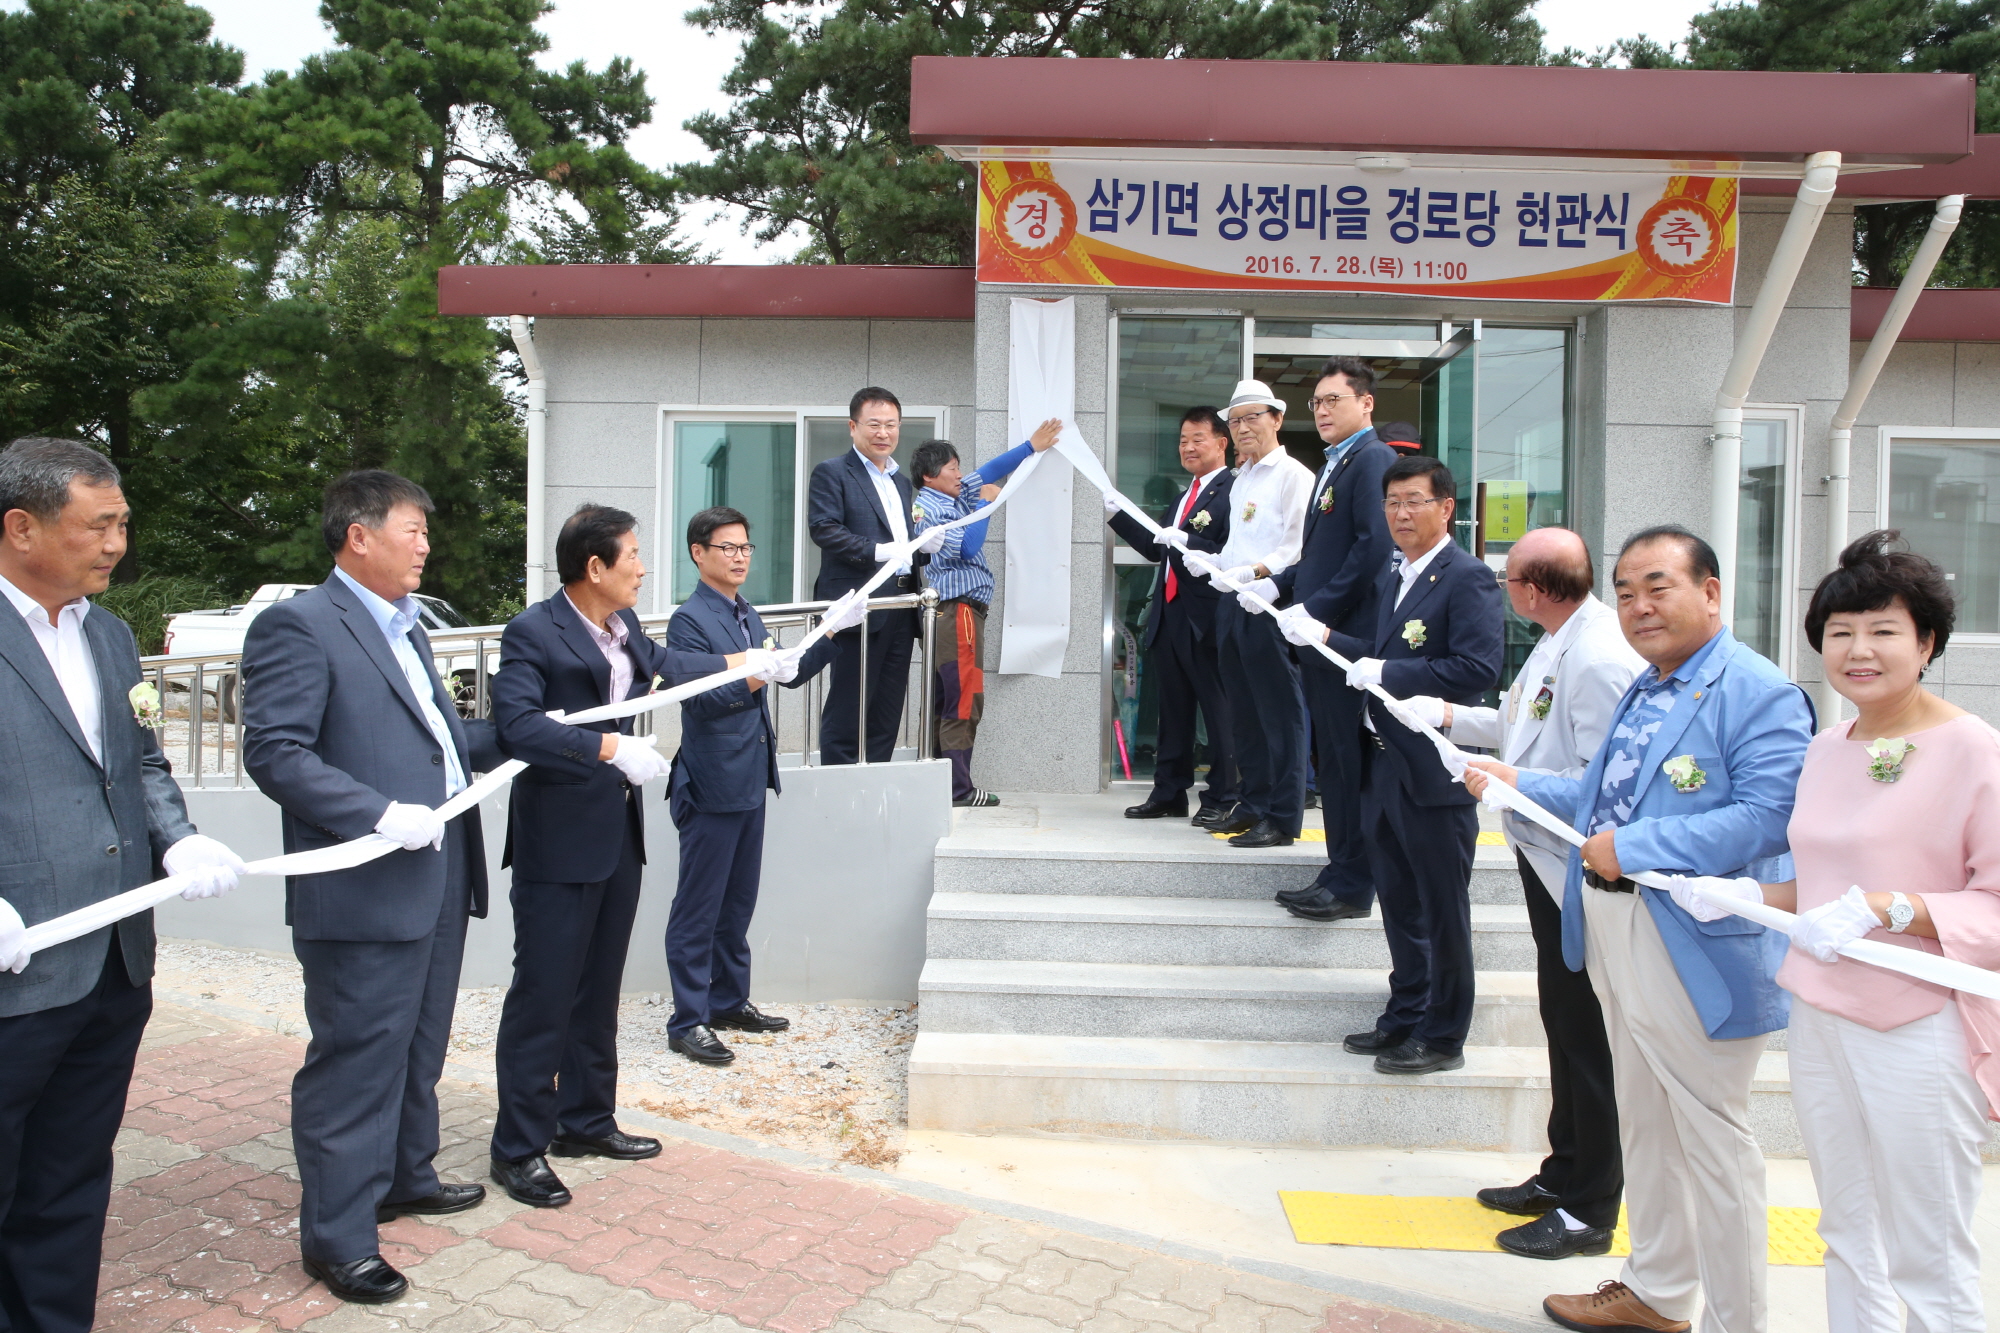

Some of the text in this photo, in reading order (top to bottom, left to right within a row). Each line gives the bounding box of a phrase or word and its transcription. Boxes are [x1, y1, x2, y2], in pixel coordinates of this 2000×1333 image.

[1013, 198, 1048, 239] 경
[1086, 177, 1629, 250] 삼기면 상정마을 경로당 현판식
[1659, 216, 1701, 257] 축
[1413, 260, 1468, 281] 11:00
